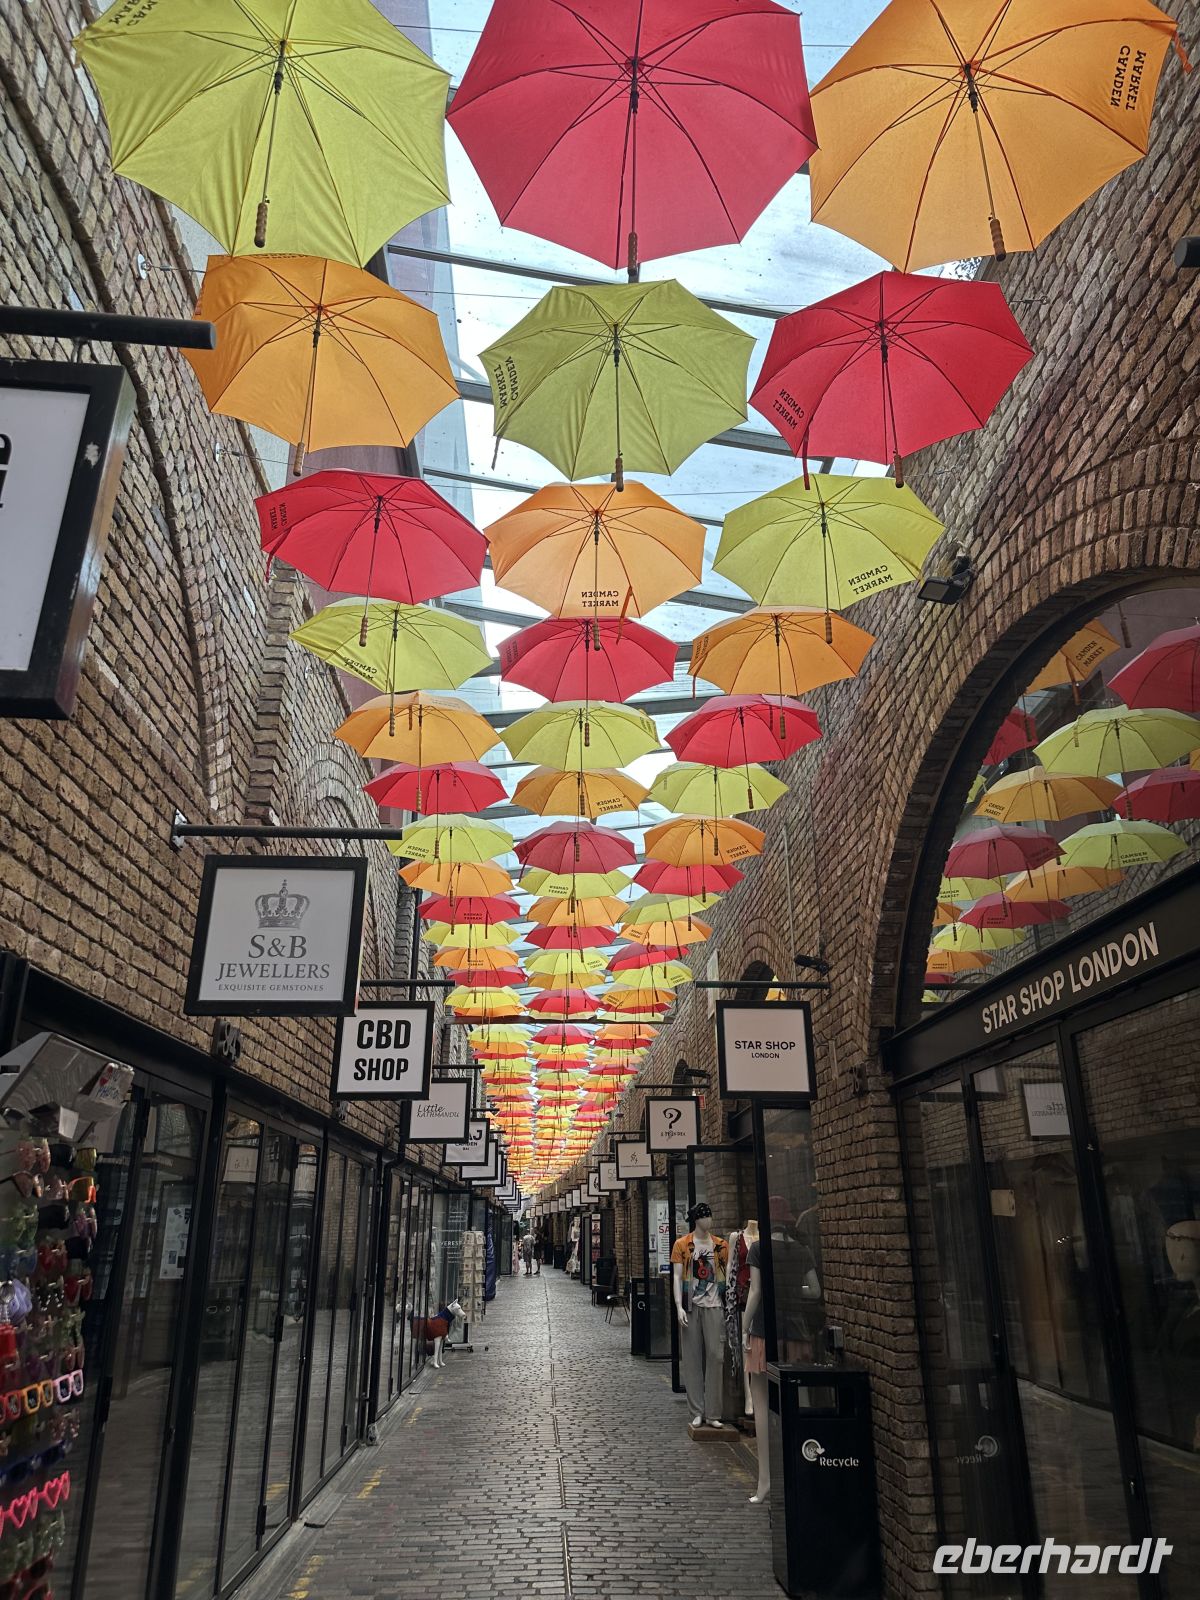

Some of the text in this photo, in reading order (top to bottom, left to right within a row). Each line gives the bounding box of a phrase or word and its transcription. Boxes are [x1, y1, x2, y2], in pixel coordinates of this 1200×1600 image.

[1076, 640, 1097, 661] CAMDEN
[1082, 646, 1105, 667] MARKET
[248, 934, 307, 959] S&B
[215, 962, 330, 982] JEWELLERS
[982, 921, 1160, 1034] STAR SHOP LONDON
[218, 983, 324, 992] EXQUISITE GEMSTONES
[356, 1019, 412, 1049] CBD
[734, 1040, 796, 1051] STAR SHOP
[353, 1057, 409, 1081] SHOP
[658, 1225, 683, 1234] SAE
[819, 1456, 860, 1468] Recycle
